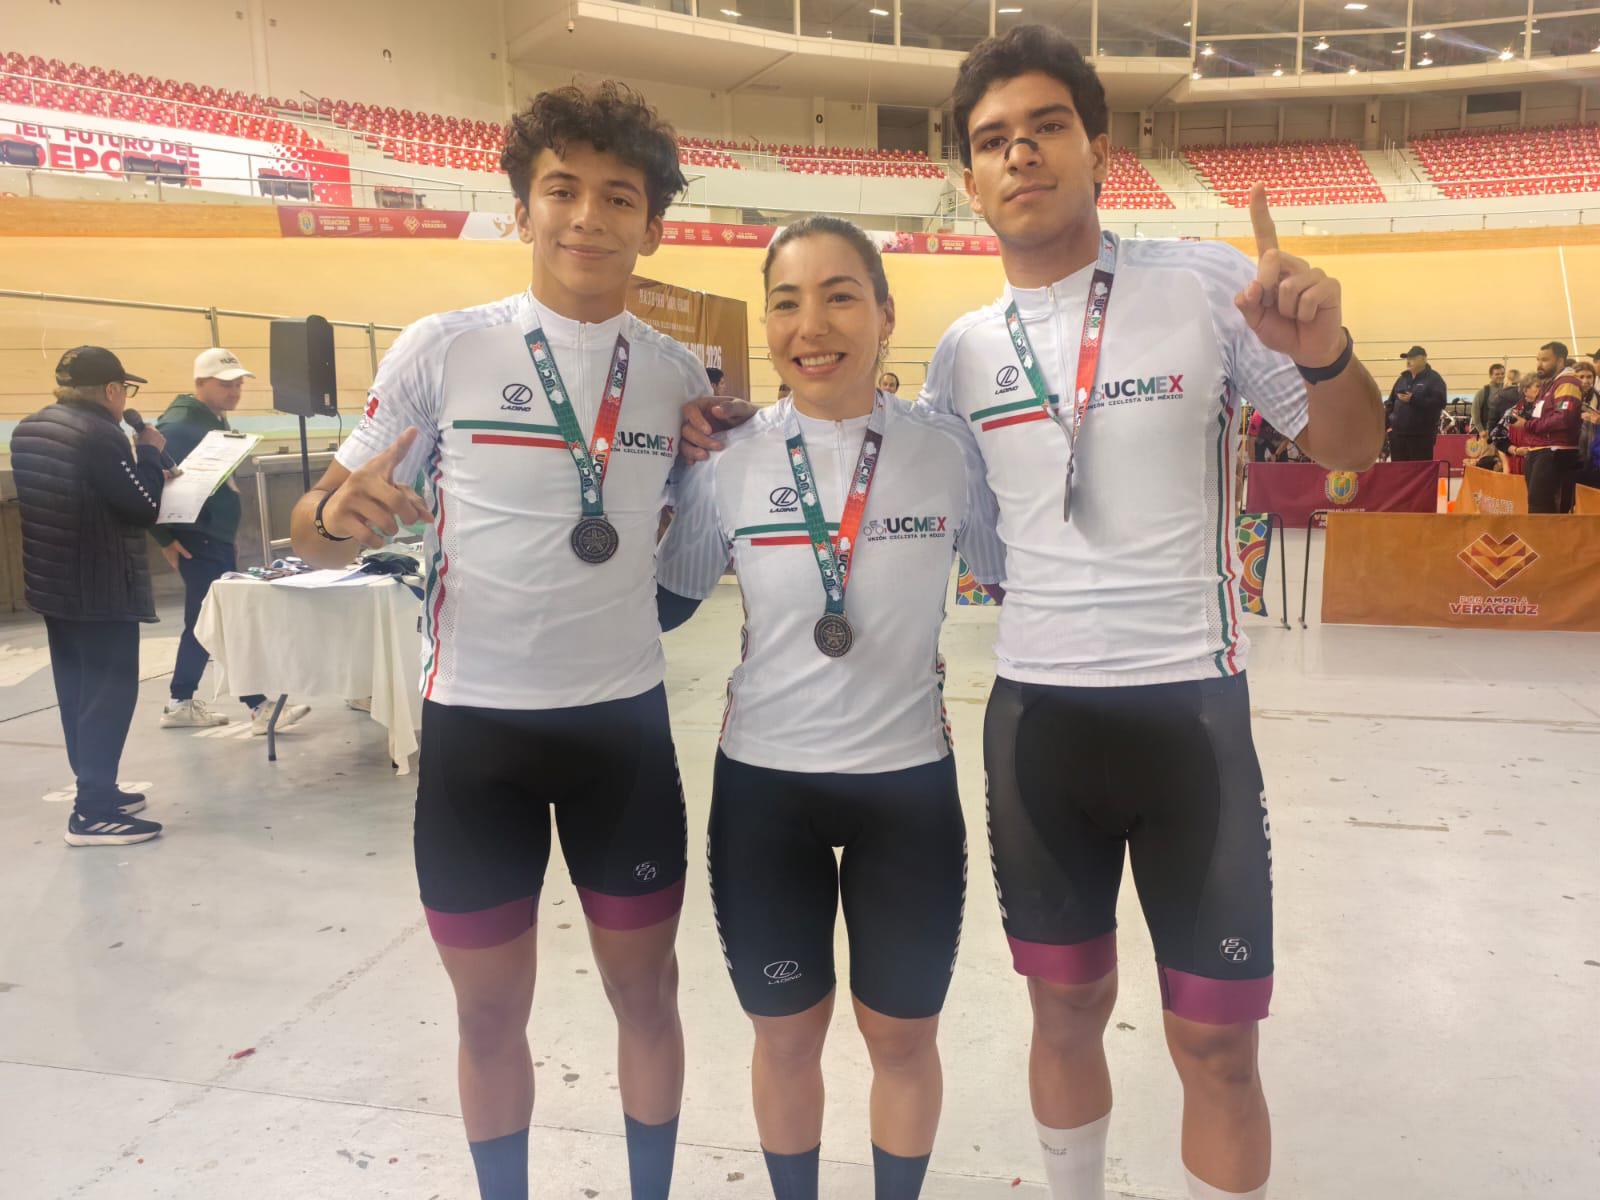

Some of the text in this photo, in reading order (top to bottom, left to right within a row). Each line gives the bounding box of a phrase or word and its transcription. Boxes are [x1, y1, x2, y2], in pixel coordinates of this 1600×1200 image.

[64, 126, 154, 152] FUTURO
[160, 139, 200, 158] DEL
[1104, 374, 1184, 399] UCMEX
[620, 431, 674, 453] UCMEX
[886, 516, 947, 534] UCMEX
[1449, 603, 1538, 616] VERACRUZ
